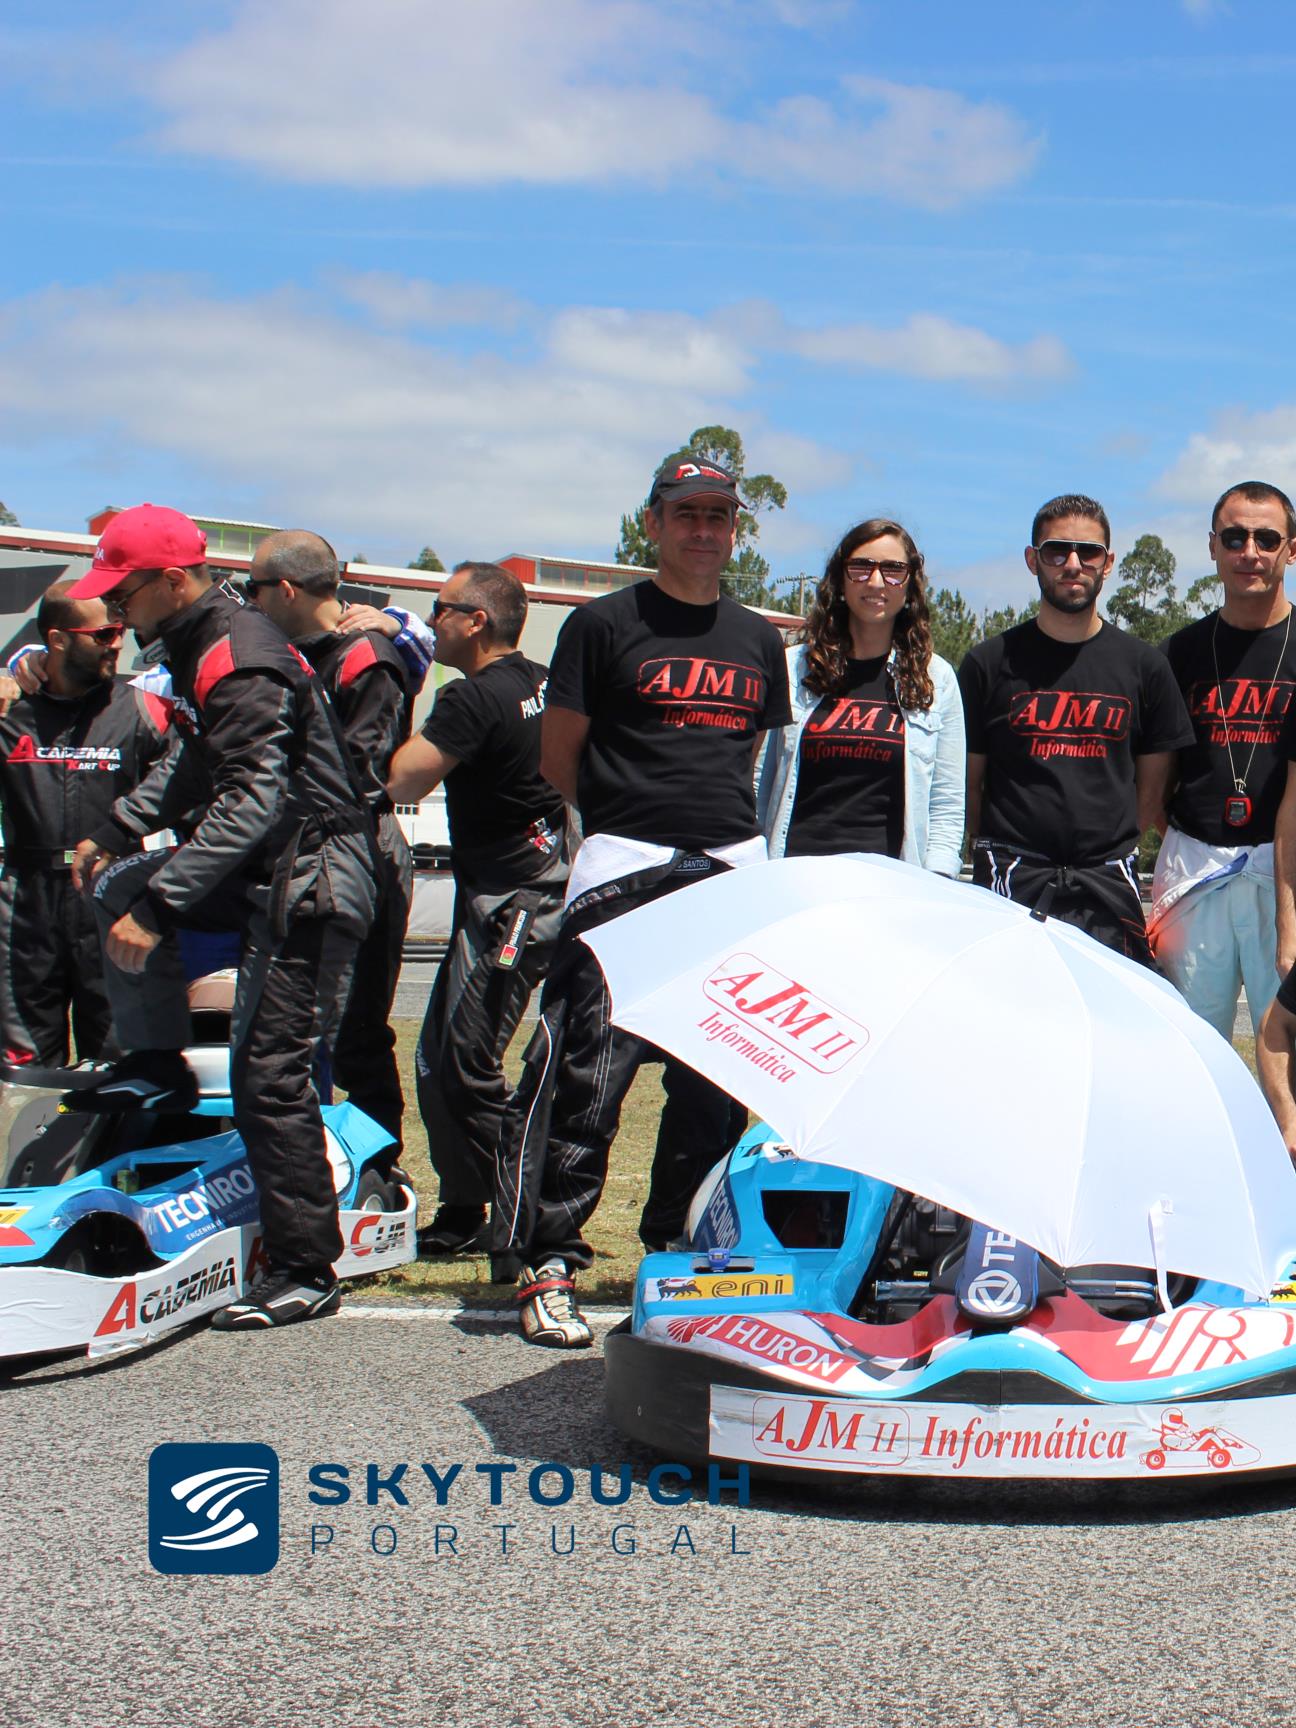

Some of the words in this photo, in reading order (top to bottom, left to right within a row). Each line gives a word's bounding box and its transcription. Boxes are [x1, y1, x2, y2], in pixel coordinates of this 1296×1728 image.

[642, 658, 737, 698] AJM
[743, 677, 760, 701] II
[662, 706, 748, 730] Informática
[809, 698, 883, 733] JM
[1013, 691, 1102, 731] AJM
[1104, 707, 1126, 731] II
[7, 734, 121, 760] ACADEMIA
[1030, 738, 1108, 760] Informática
[683, 858, 709, 869] SANTOS
[708, 971, 833, 1041] AJM
[810, 1031, 857, 1062] II
[697, 1012, 796, 1084] Informática
[93, 1257, 237, 1336] ACADEMIA
[712, 1274, 786, 1298] eni
[725, 1319, 844, 1377] HURON
[755, 1400, 865, 1452] AJM
[871, 1422, 901, 1453] II
[920, 1416, 1127, 1469] Informática
